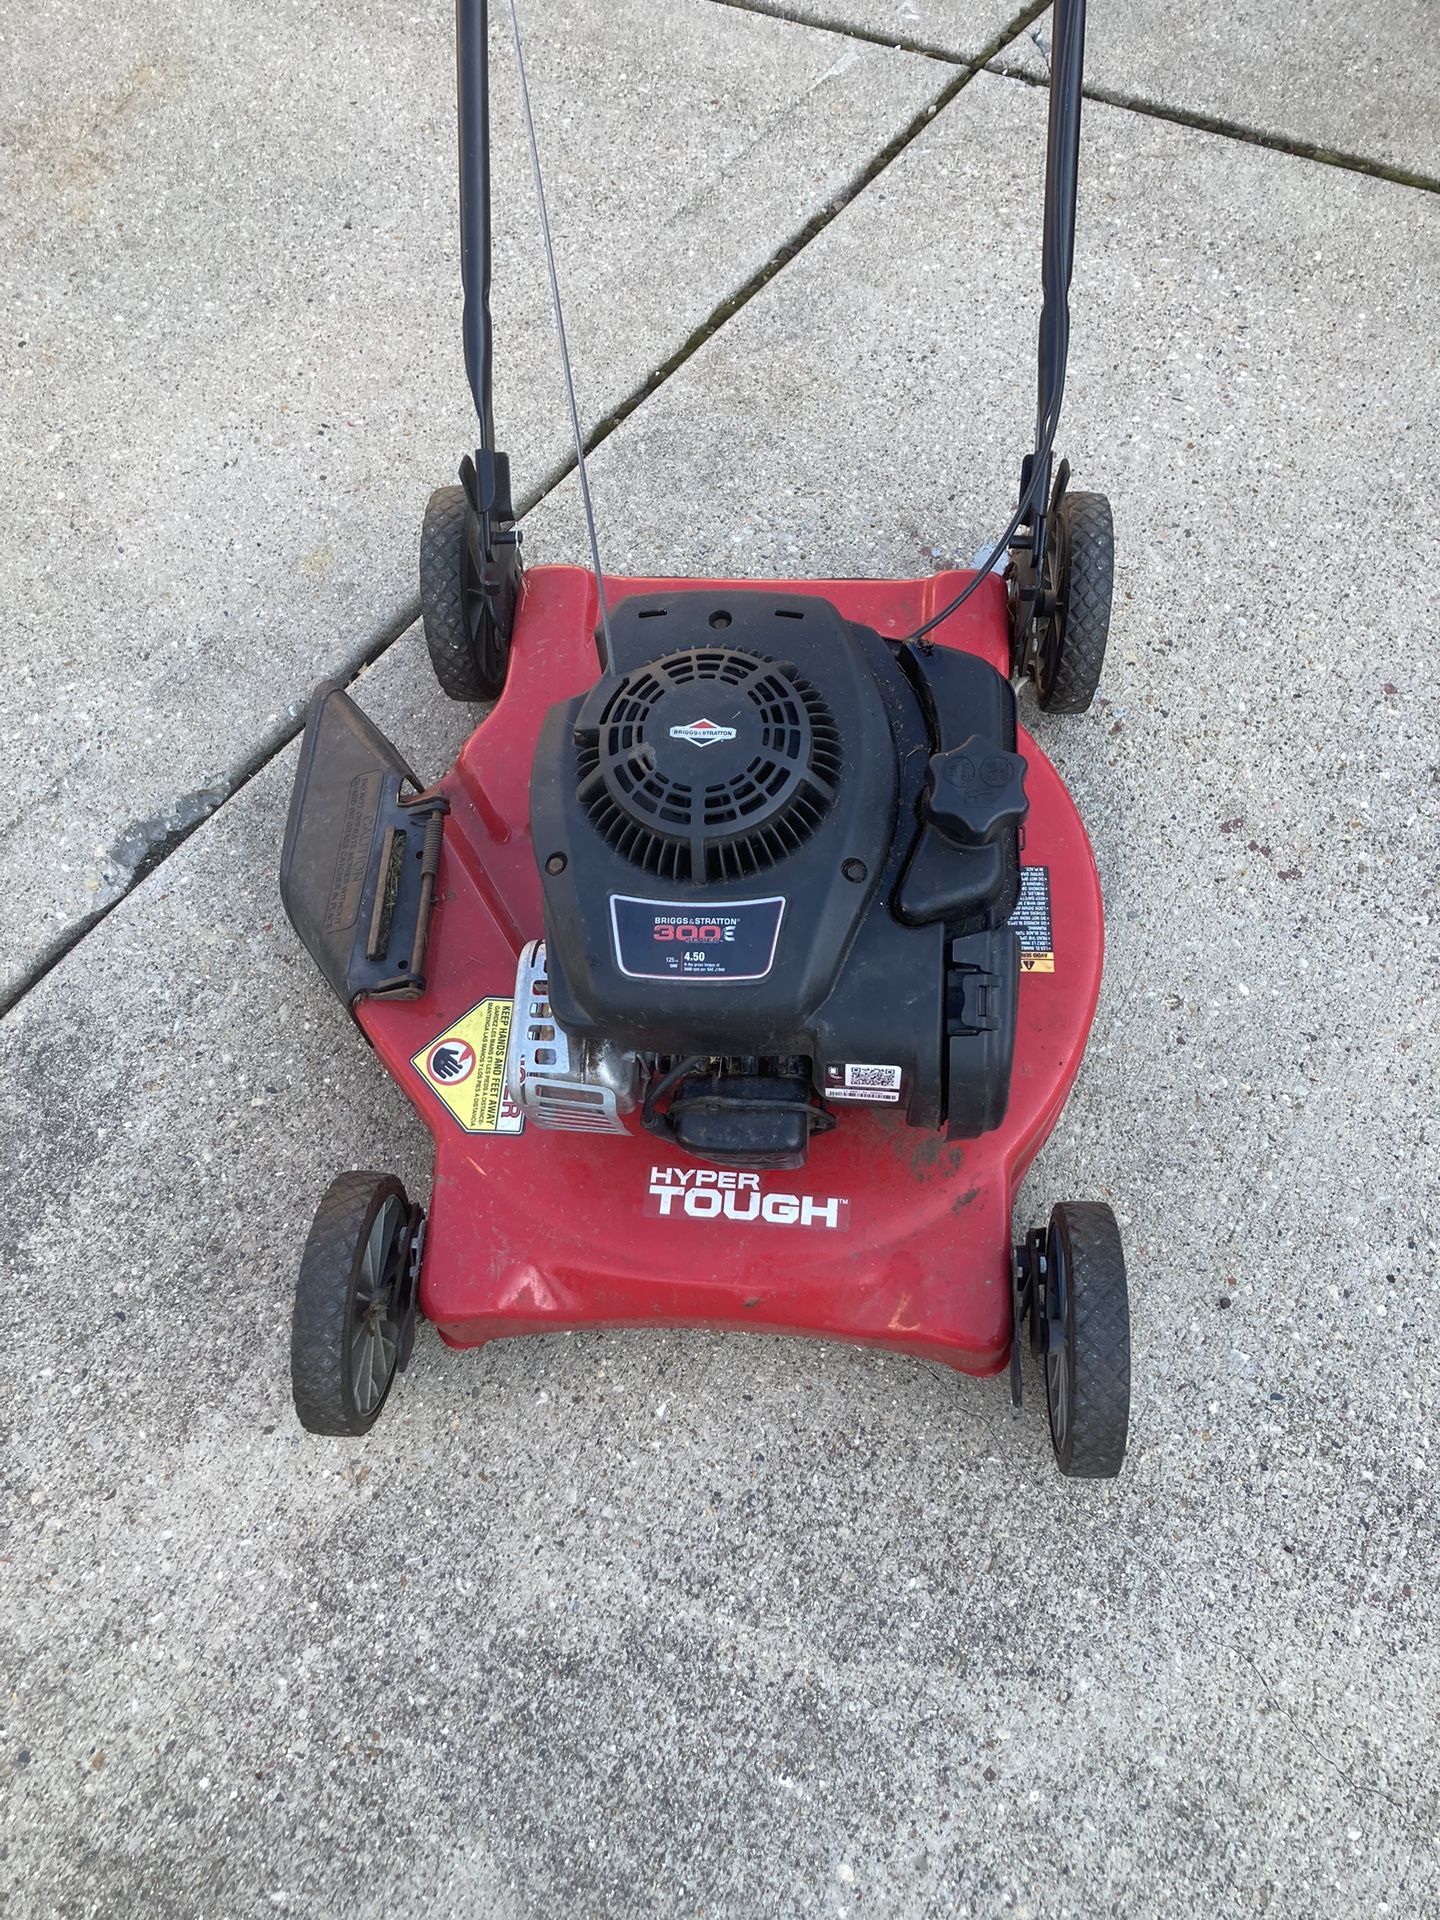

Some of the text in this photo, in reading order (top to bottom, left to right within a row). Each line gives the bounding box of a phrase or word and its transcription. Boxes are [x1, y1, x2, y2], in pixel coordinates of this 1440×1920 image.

[353, 816, 375, 881] CAUTION
[684, 952, 705, 961] 4.50
[484, 1003, 493, 1031] MANTENGA
[492, 1006, 500, 1027] GARDEZ
[479, 1044, 487, 1062] MANOS
[488, 1039, 496, 1055] MAINS
[486, 1006, 511, 1125] KEEP HANDS AND FEET AWAY
[470, 1098, 479, 1126] DISTANCIA
[650, 1166, 760, 1190] HYPER
